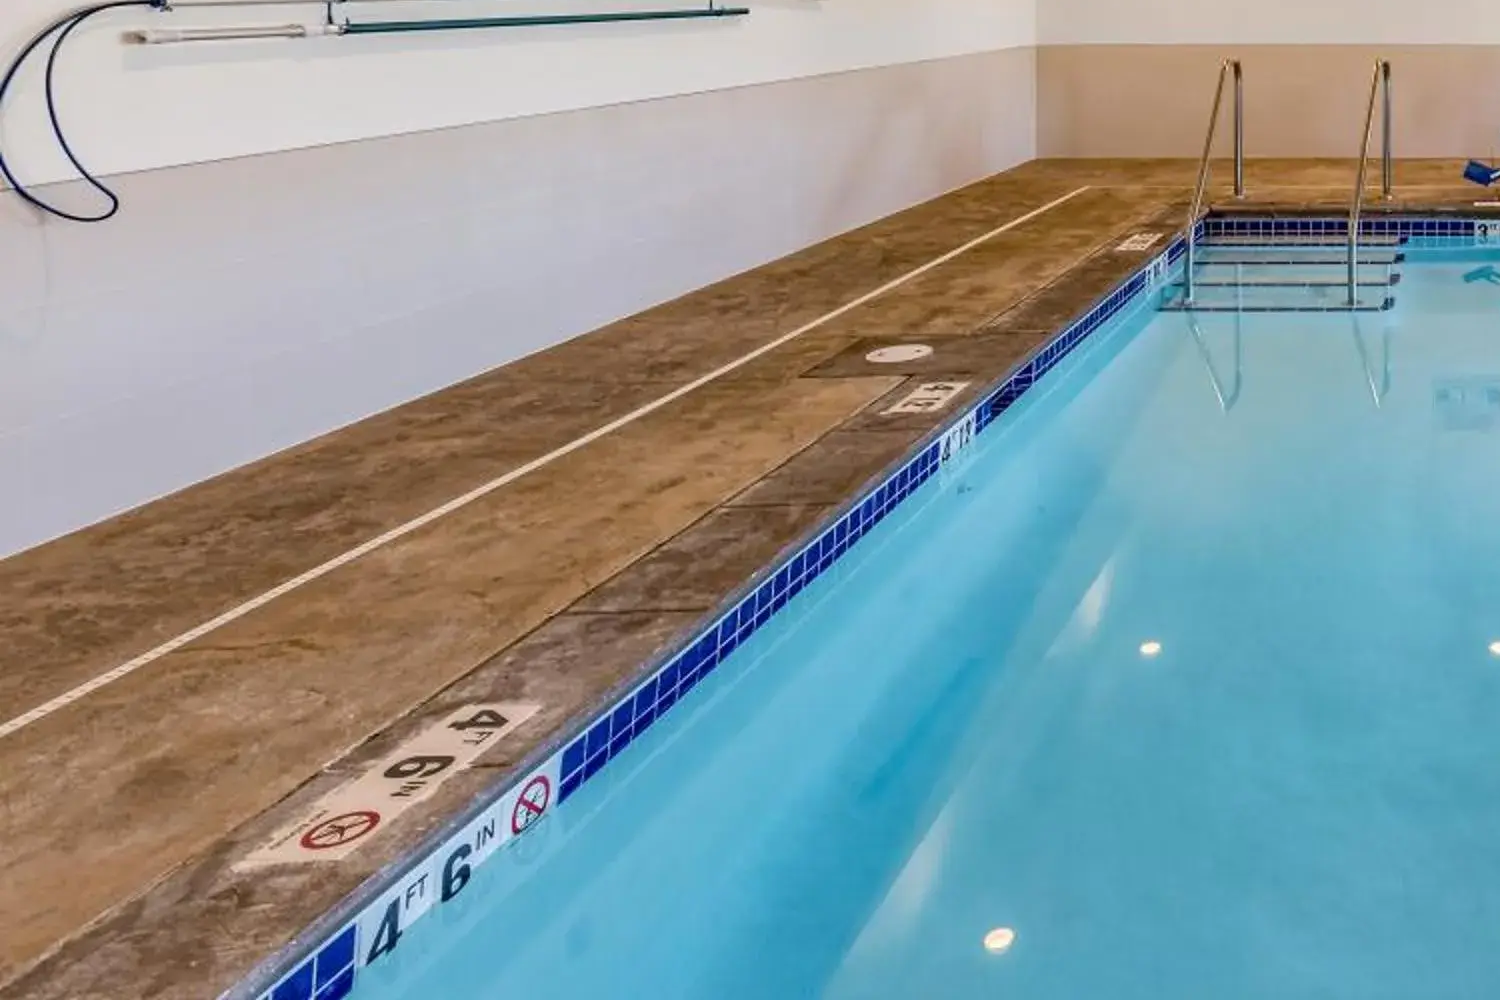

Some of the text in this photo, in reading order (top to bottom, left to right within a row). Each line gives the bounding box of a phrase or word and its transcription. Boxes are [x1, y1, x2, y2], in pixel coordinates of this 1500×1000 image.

[448, 709, 508, 730] 4
[384, 755, 455, 778] 6
[365, 818, 496, 966] 4 FT 6 IN
